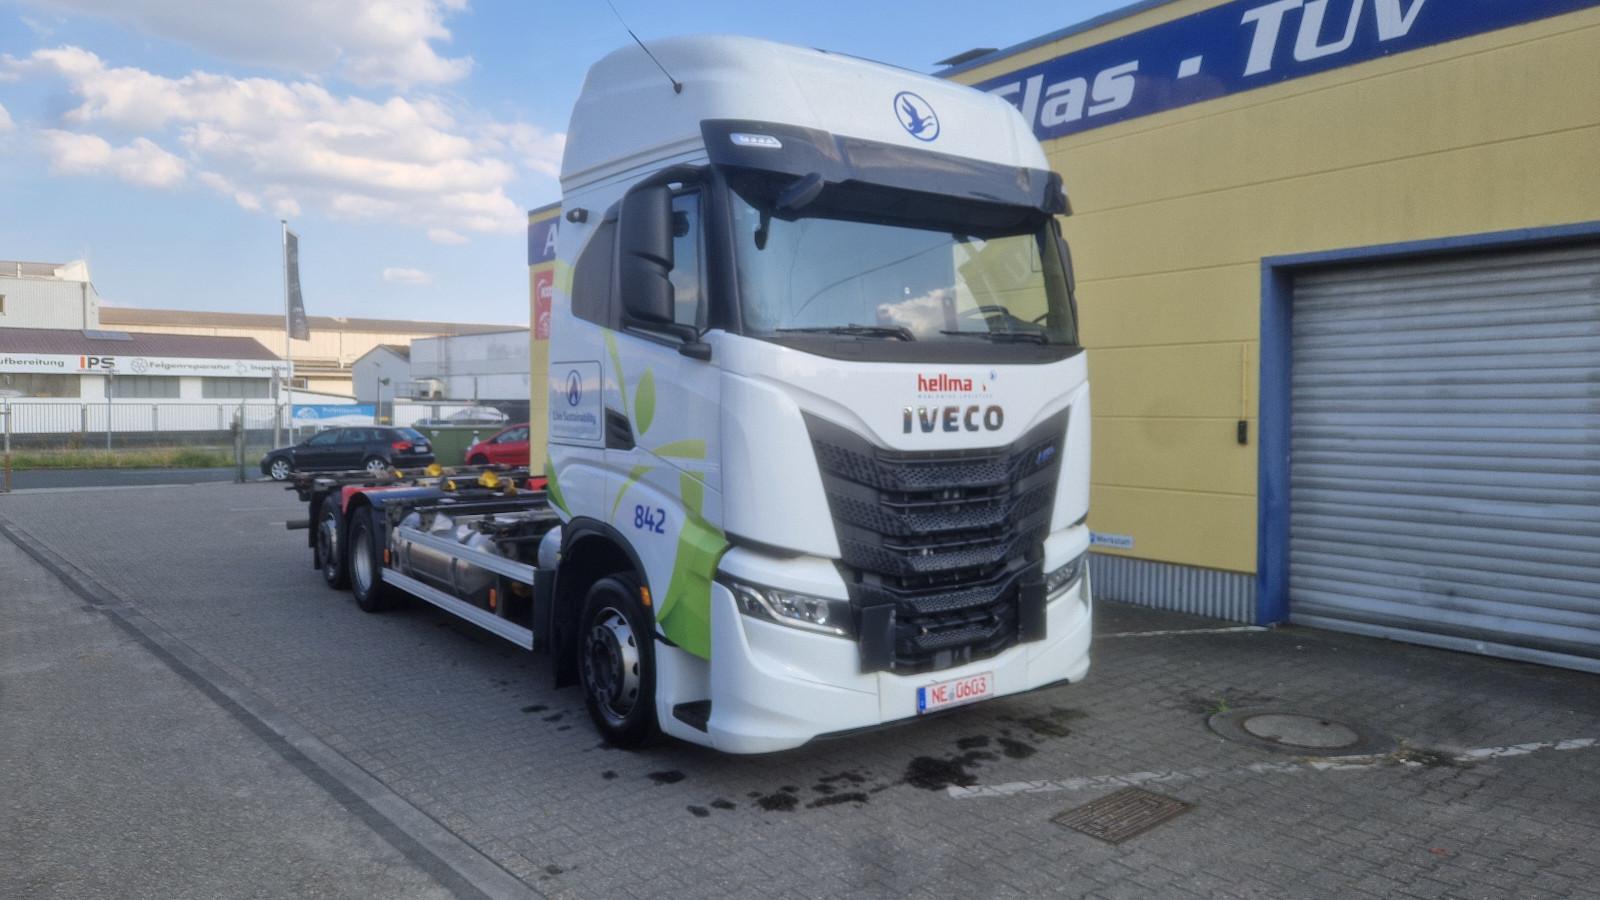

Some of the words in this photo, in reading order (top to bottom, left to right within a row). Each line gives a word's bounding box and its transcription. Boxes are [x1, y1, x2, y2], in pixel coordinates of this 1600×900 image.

[986, 60, 1139, 132] las
[917, 374, 972, 392] hellma
[902, 404, 1004, 434] IVECO
[634, 504, 666, 535] 842
[931, 685, 948, 704] NE
